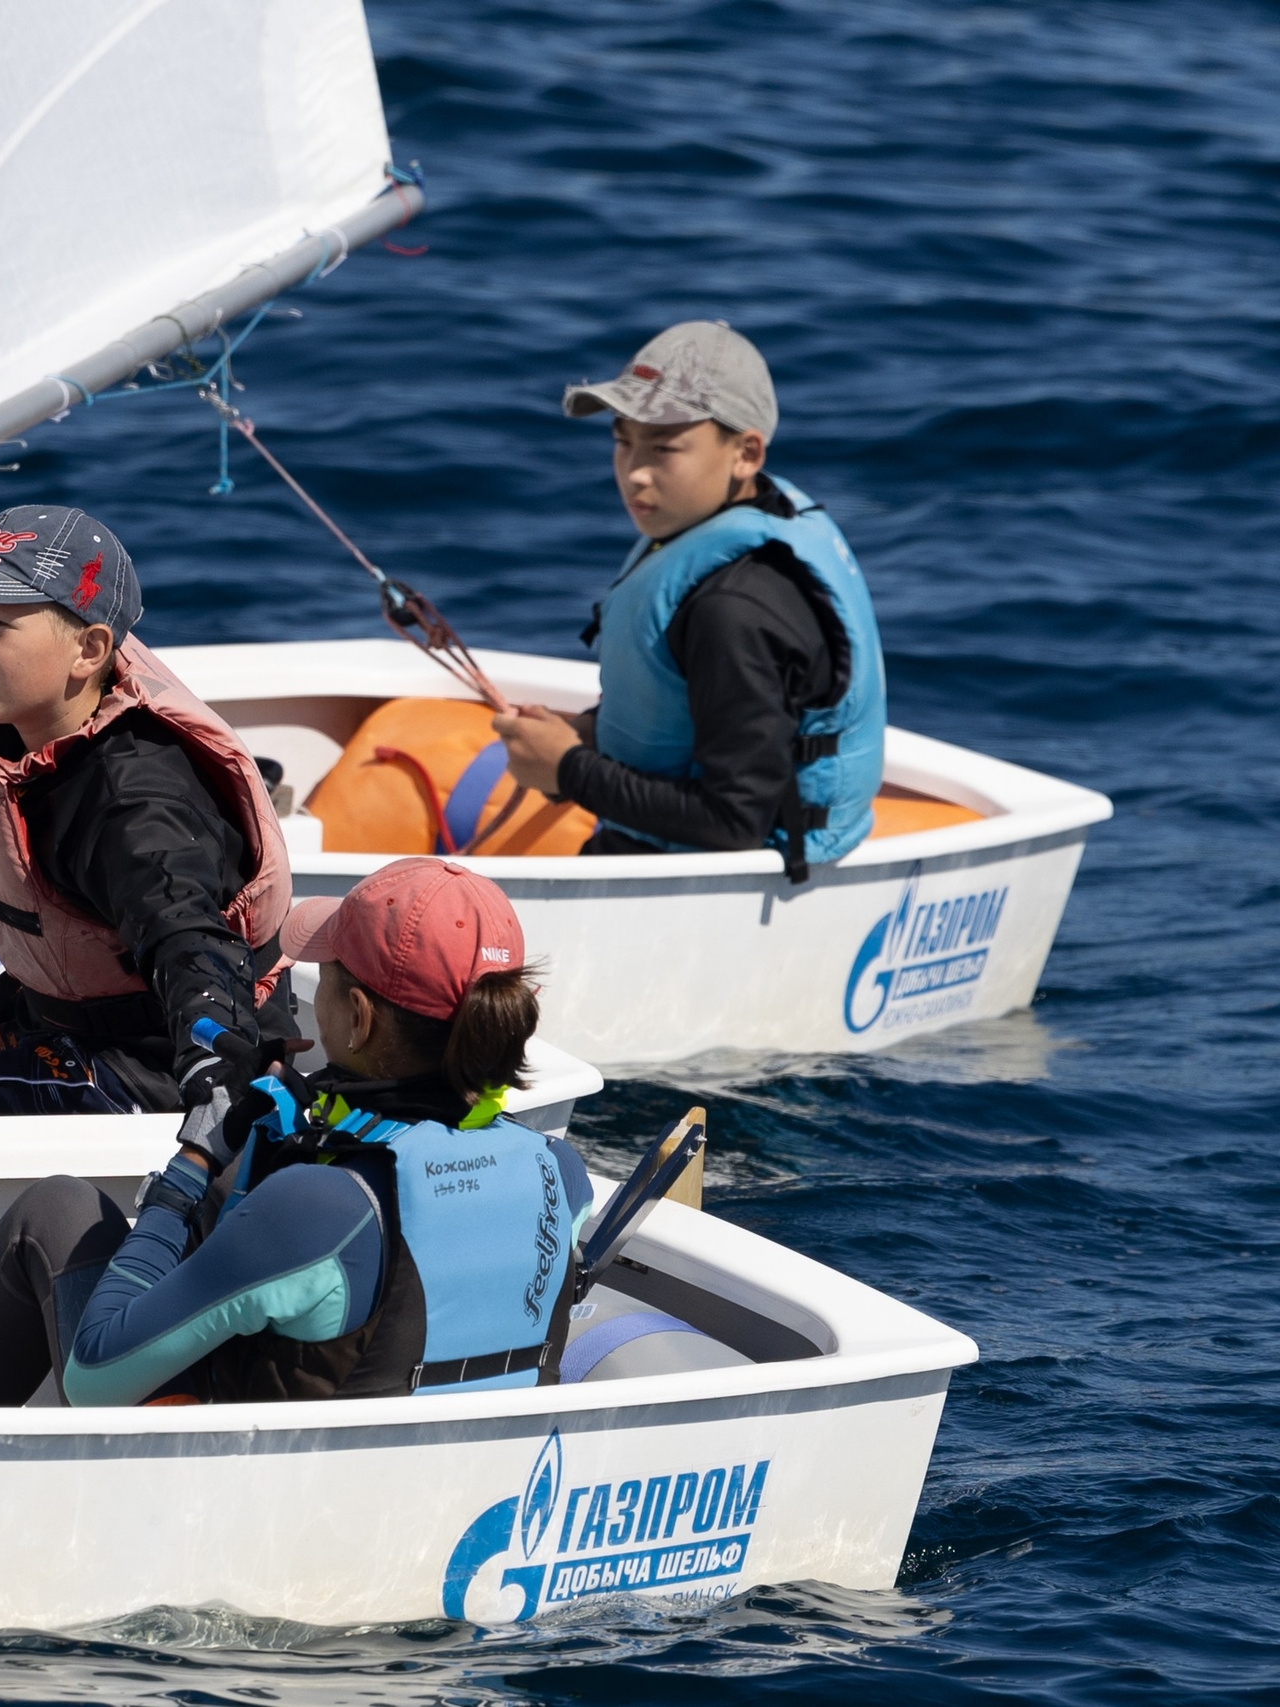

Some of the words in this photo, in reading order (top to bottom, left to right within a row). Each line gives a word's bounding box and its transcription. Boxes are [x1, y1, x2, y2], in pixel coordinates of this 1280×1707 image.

[481, 947, 510, 963] NIKE
[904, 886, 1008, 959] ГАЗПРОМ
[524, 1161, 559, 1327] feelfree
[557, 1460, 770, 1553] ГАЗПРОМ
[551, 1556, 652, 1600] ДОБЫЧА
[656, 1541, 742, 1580] ШЕЛЬФ
